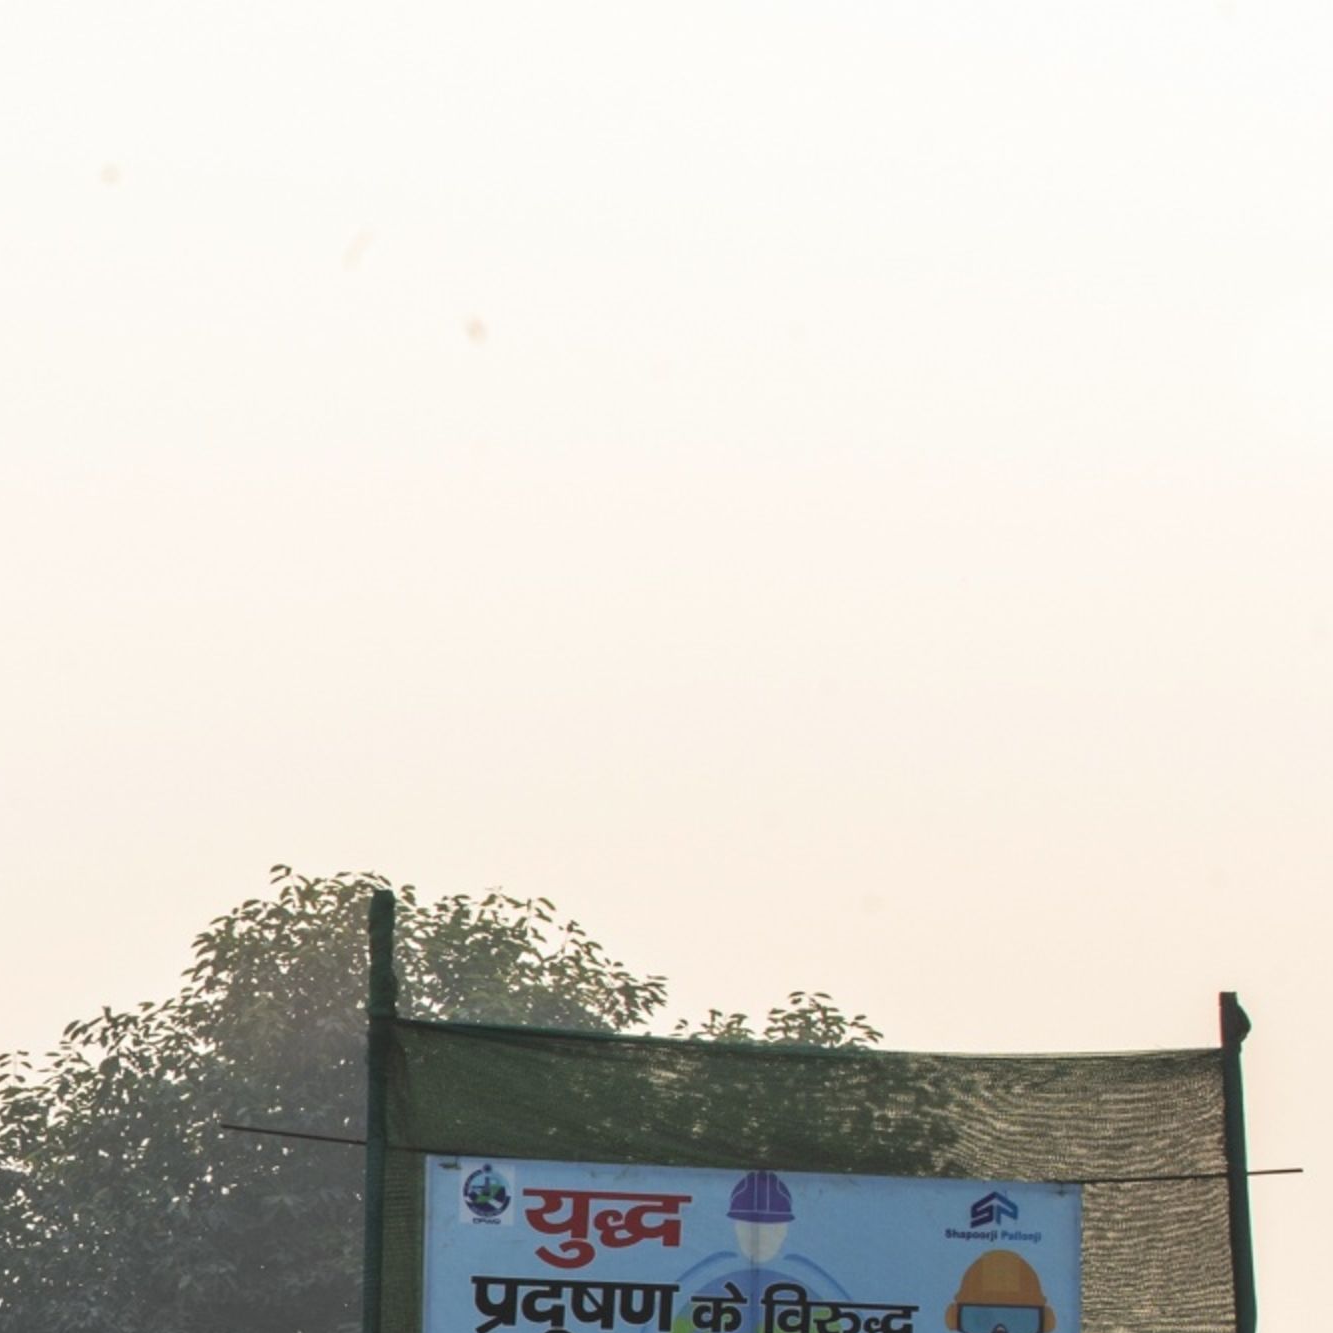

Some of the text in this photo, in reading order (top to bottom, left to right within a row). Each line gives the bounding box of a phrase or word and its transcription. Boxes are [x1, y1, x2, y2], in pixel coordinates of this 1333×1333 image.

[523, 1187, 692, 1269] युद्ध
[945, 1228, 1042, 1243] Shapoorji Pallonji
[691, 1281, 747, 1333] के
